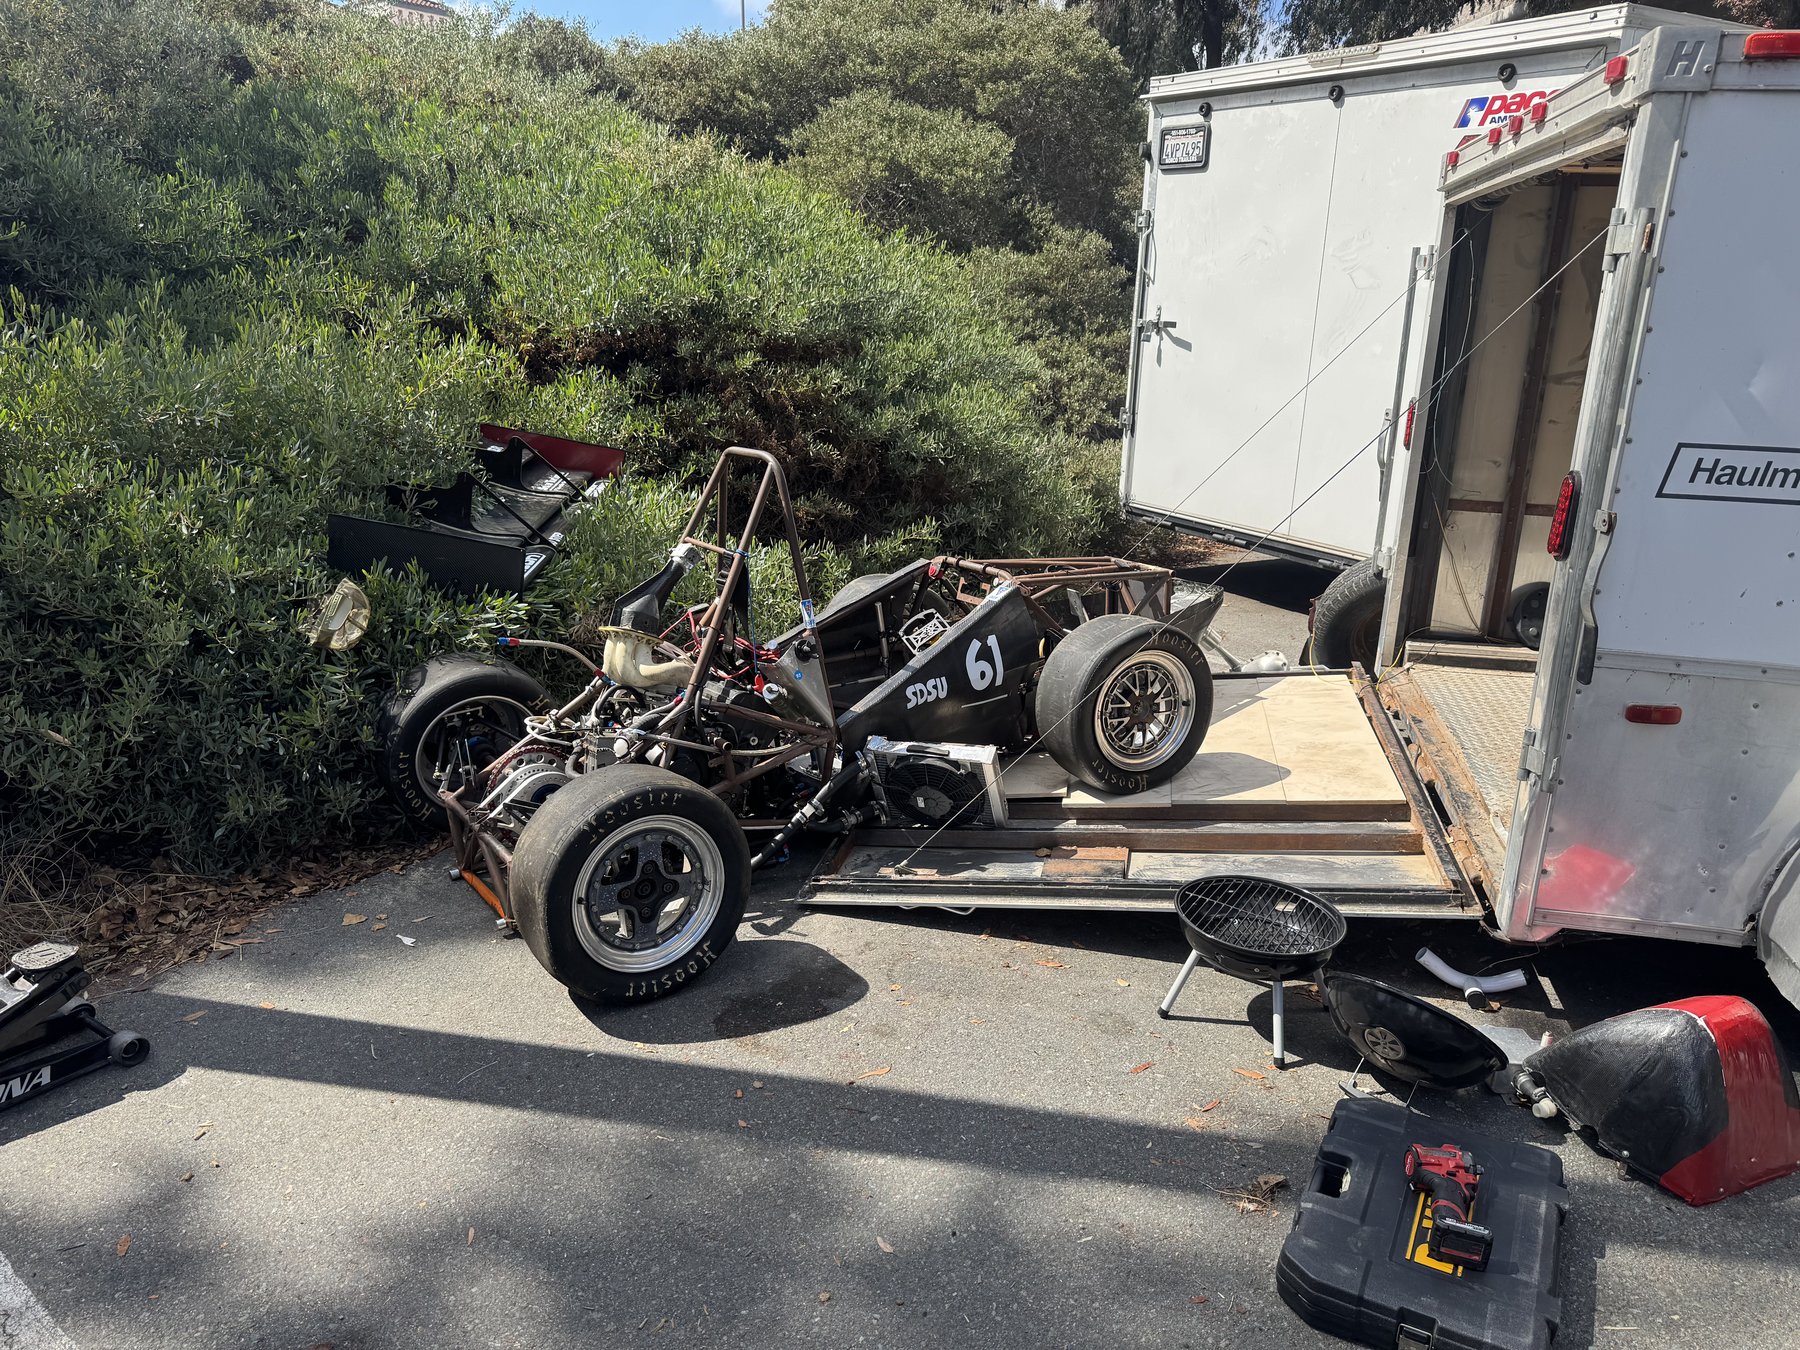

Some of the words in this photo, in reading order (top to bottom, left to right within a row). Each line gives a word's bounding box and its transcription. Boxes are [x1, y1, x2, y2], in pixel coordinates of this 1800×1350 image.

[1665, 40, 1706, 79] H
[1478, 89, 1561, 126] pac
[1165, 141, 1201, 158] 4VP7495
[1688, 457, 1800, 489] Haulm
[965, 634, 1004, 691] 61
[905, 676, 948, 710] SDSU
